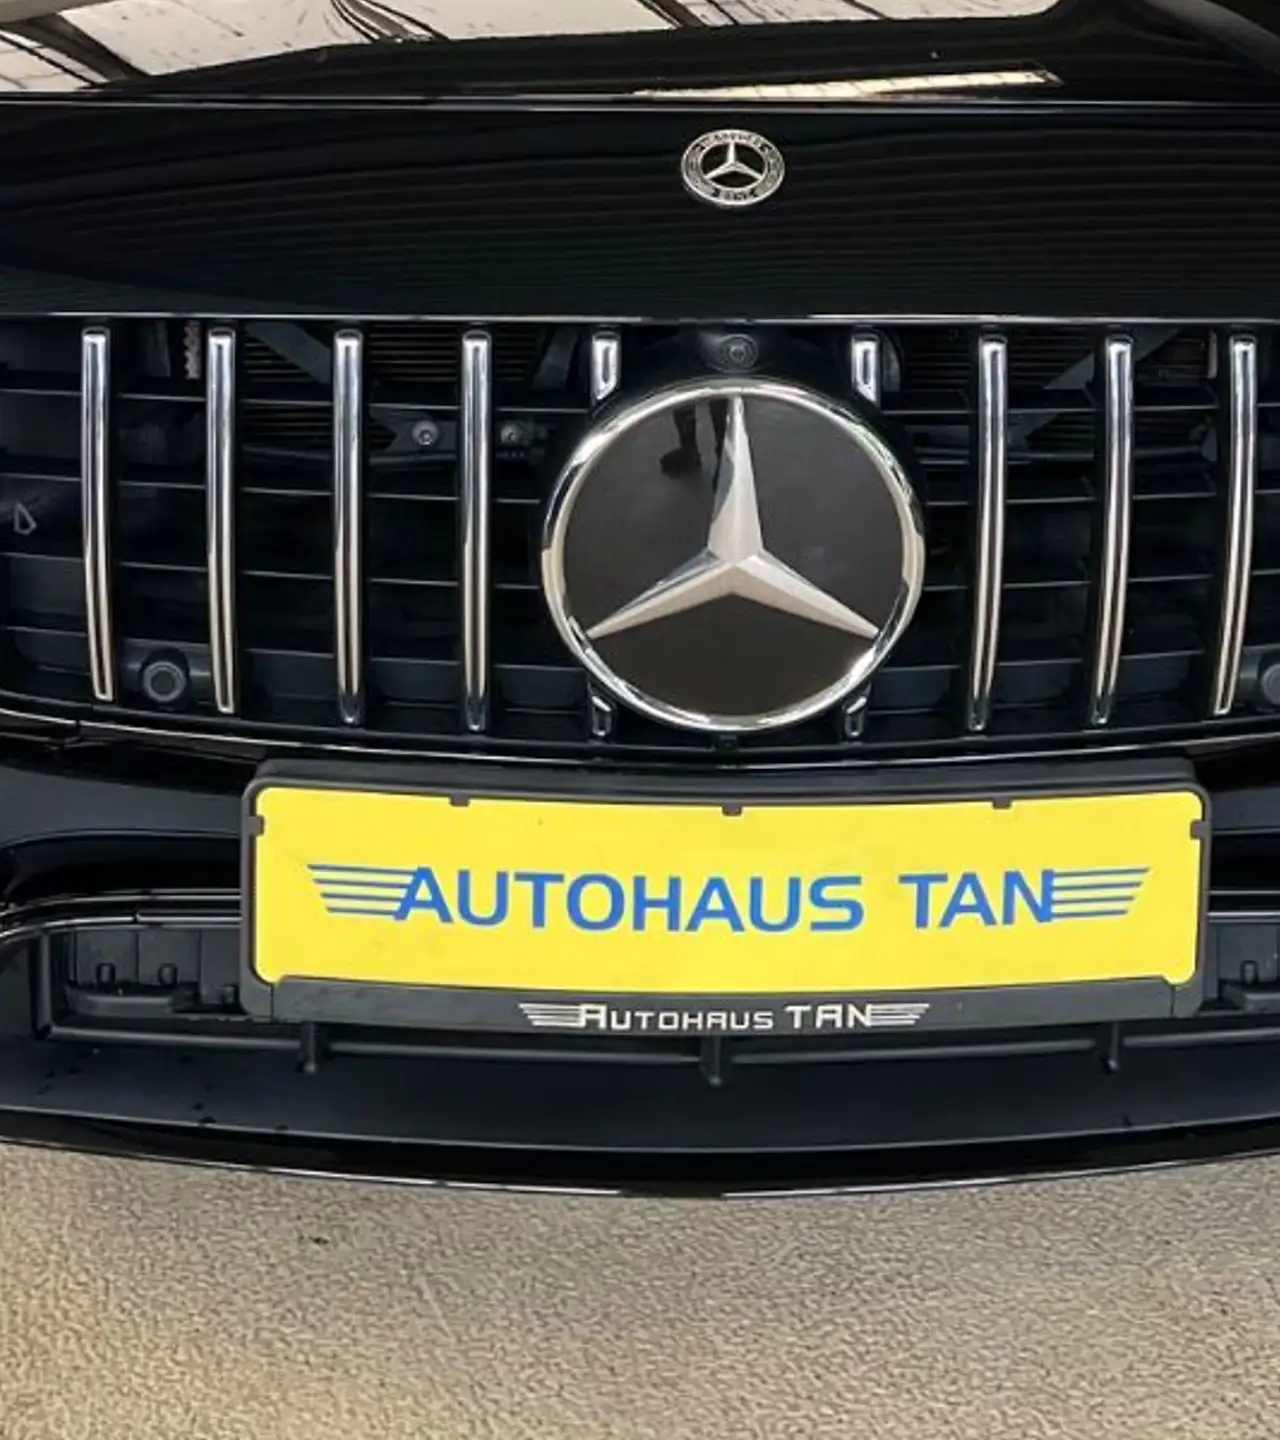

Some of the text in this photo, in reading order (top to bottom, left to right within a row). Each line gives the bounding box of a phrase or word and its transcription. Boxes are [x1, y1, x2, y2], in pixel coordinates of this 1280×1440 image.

[394, 865, 1054, 934] AUTOHAUS TAN
[784, 1003, 872, 1029] TAN
